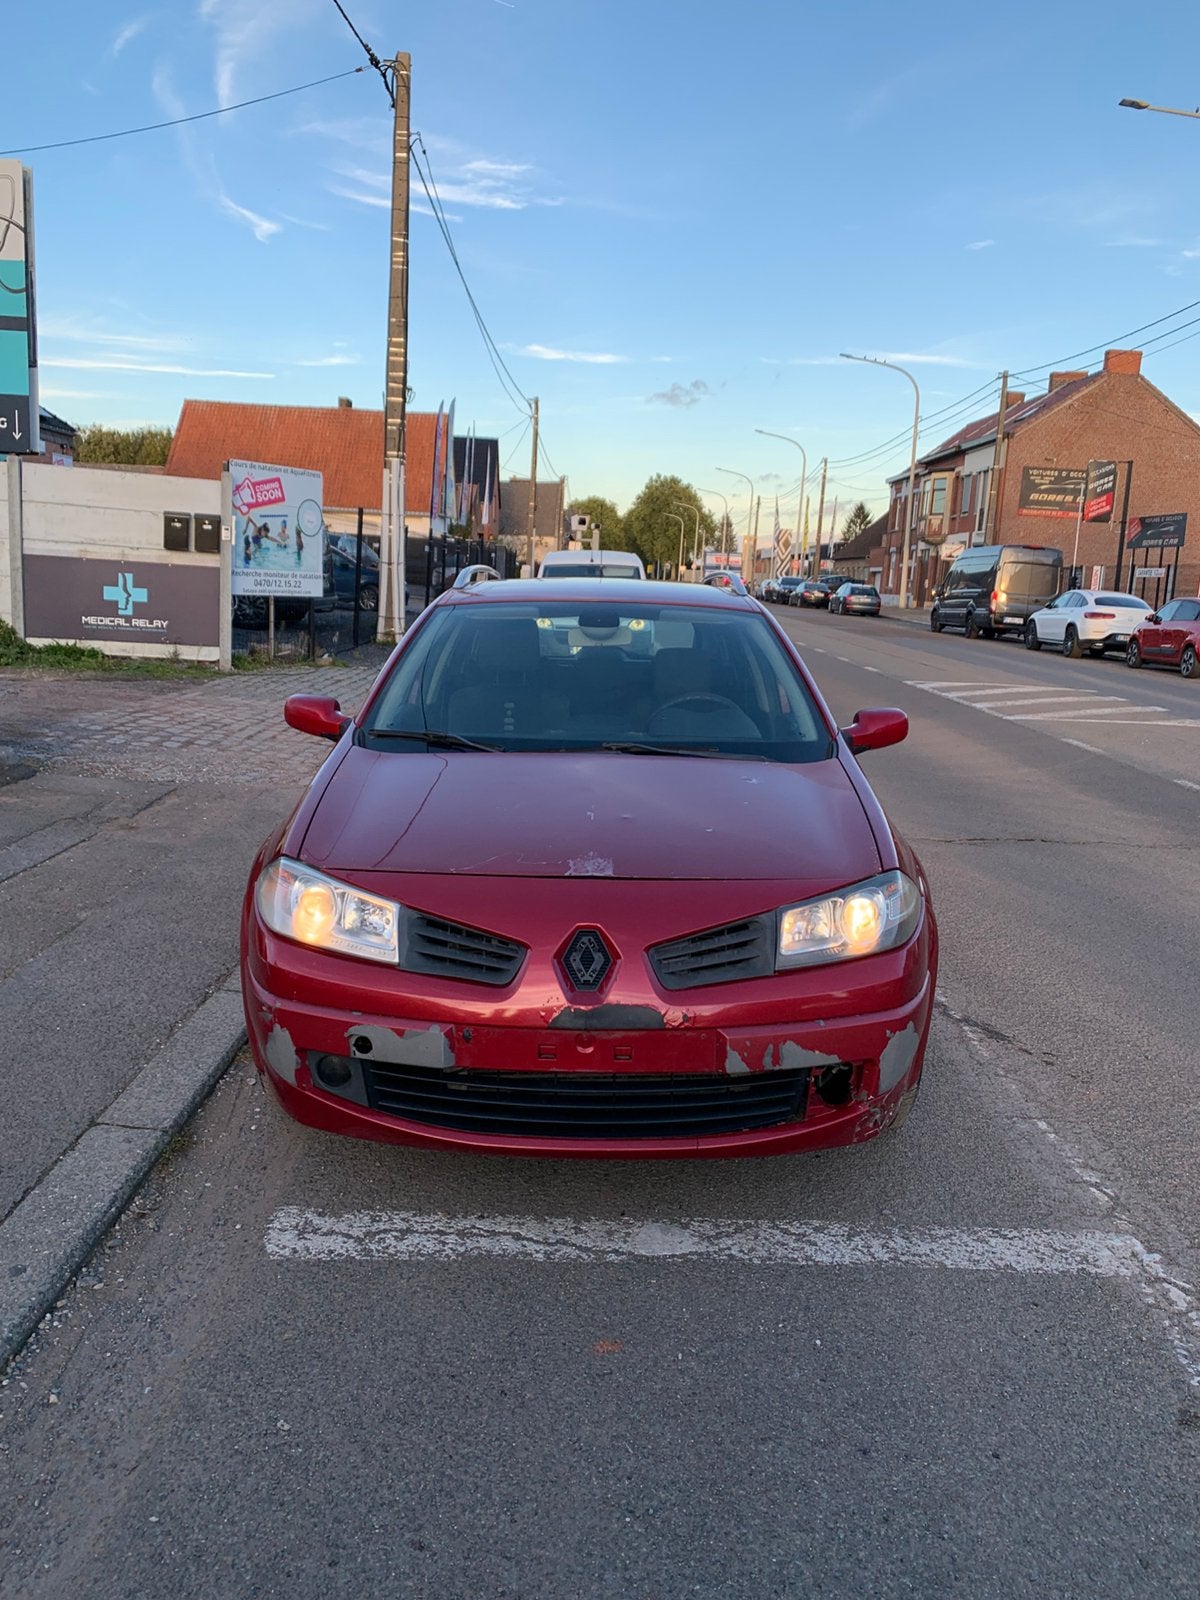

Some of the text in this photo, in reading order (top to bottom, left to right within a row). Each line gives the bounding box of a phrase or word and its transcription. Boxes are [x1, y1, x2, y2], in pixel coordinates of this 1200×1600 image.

[258, 464, 282, 472] natation
[1029, 469, 1058, 477] VOITURES
[255, 481, 280, 492] COMING
[256, 487, 283, 502] SOON
[232, 569, 261, 577] Recherche
[263, 571, 290, 579] moniteur
[253, 579, 302, 588] 0470/12.15.22
[82, 616, 168, 628] MEDICAL RELAY
